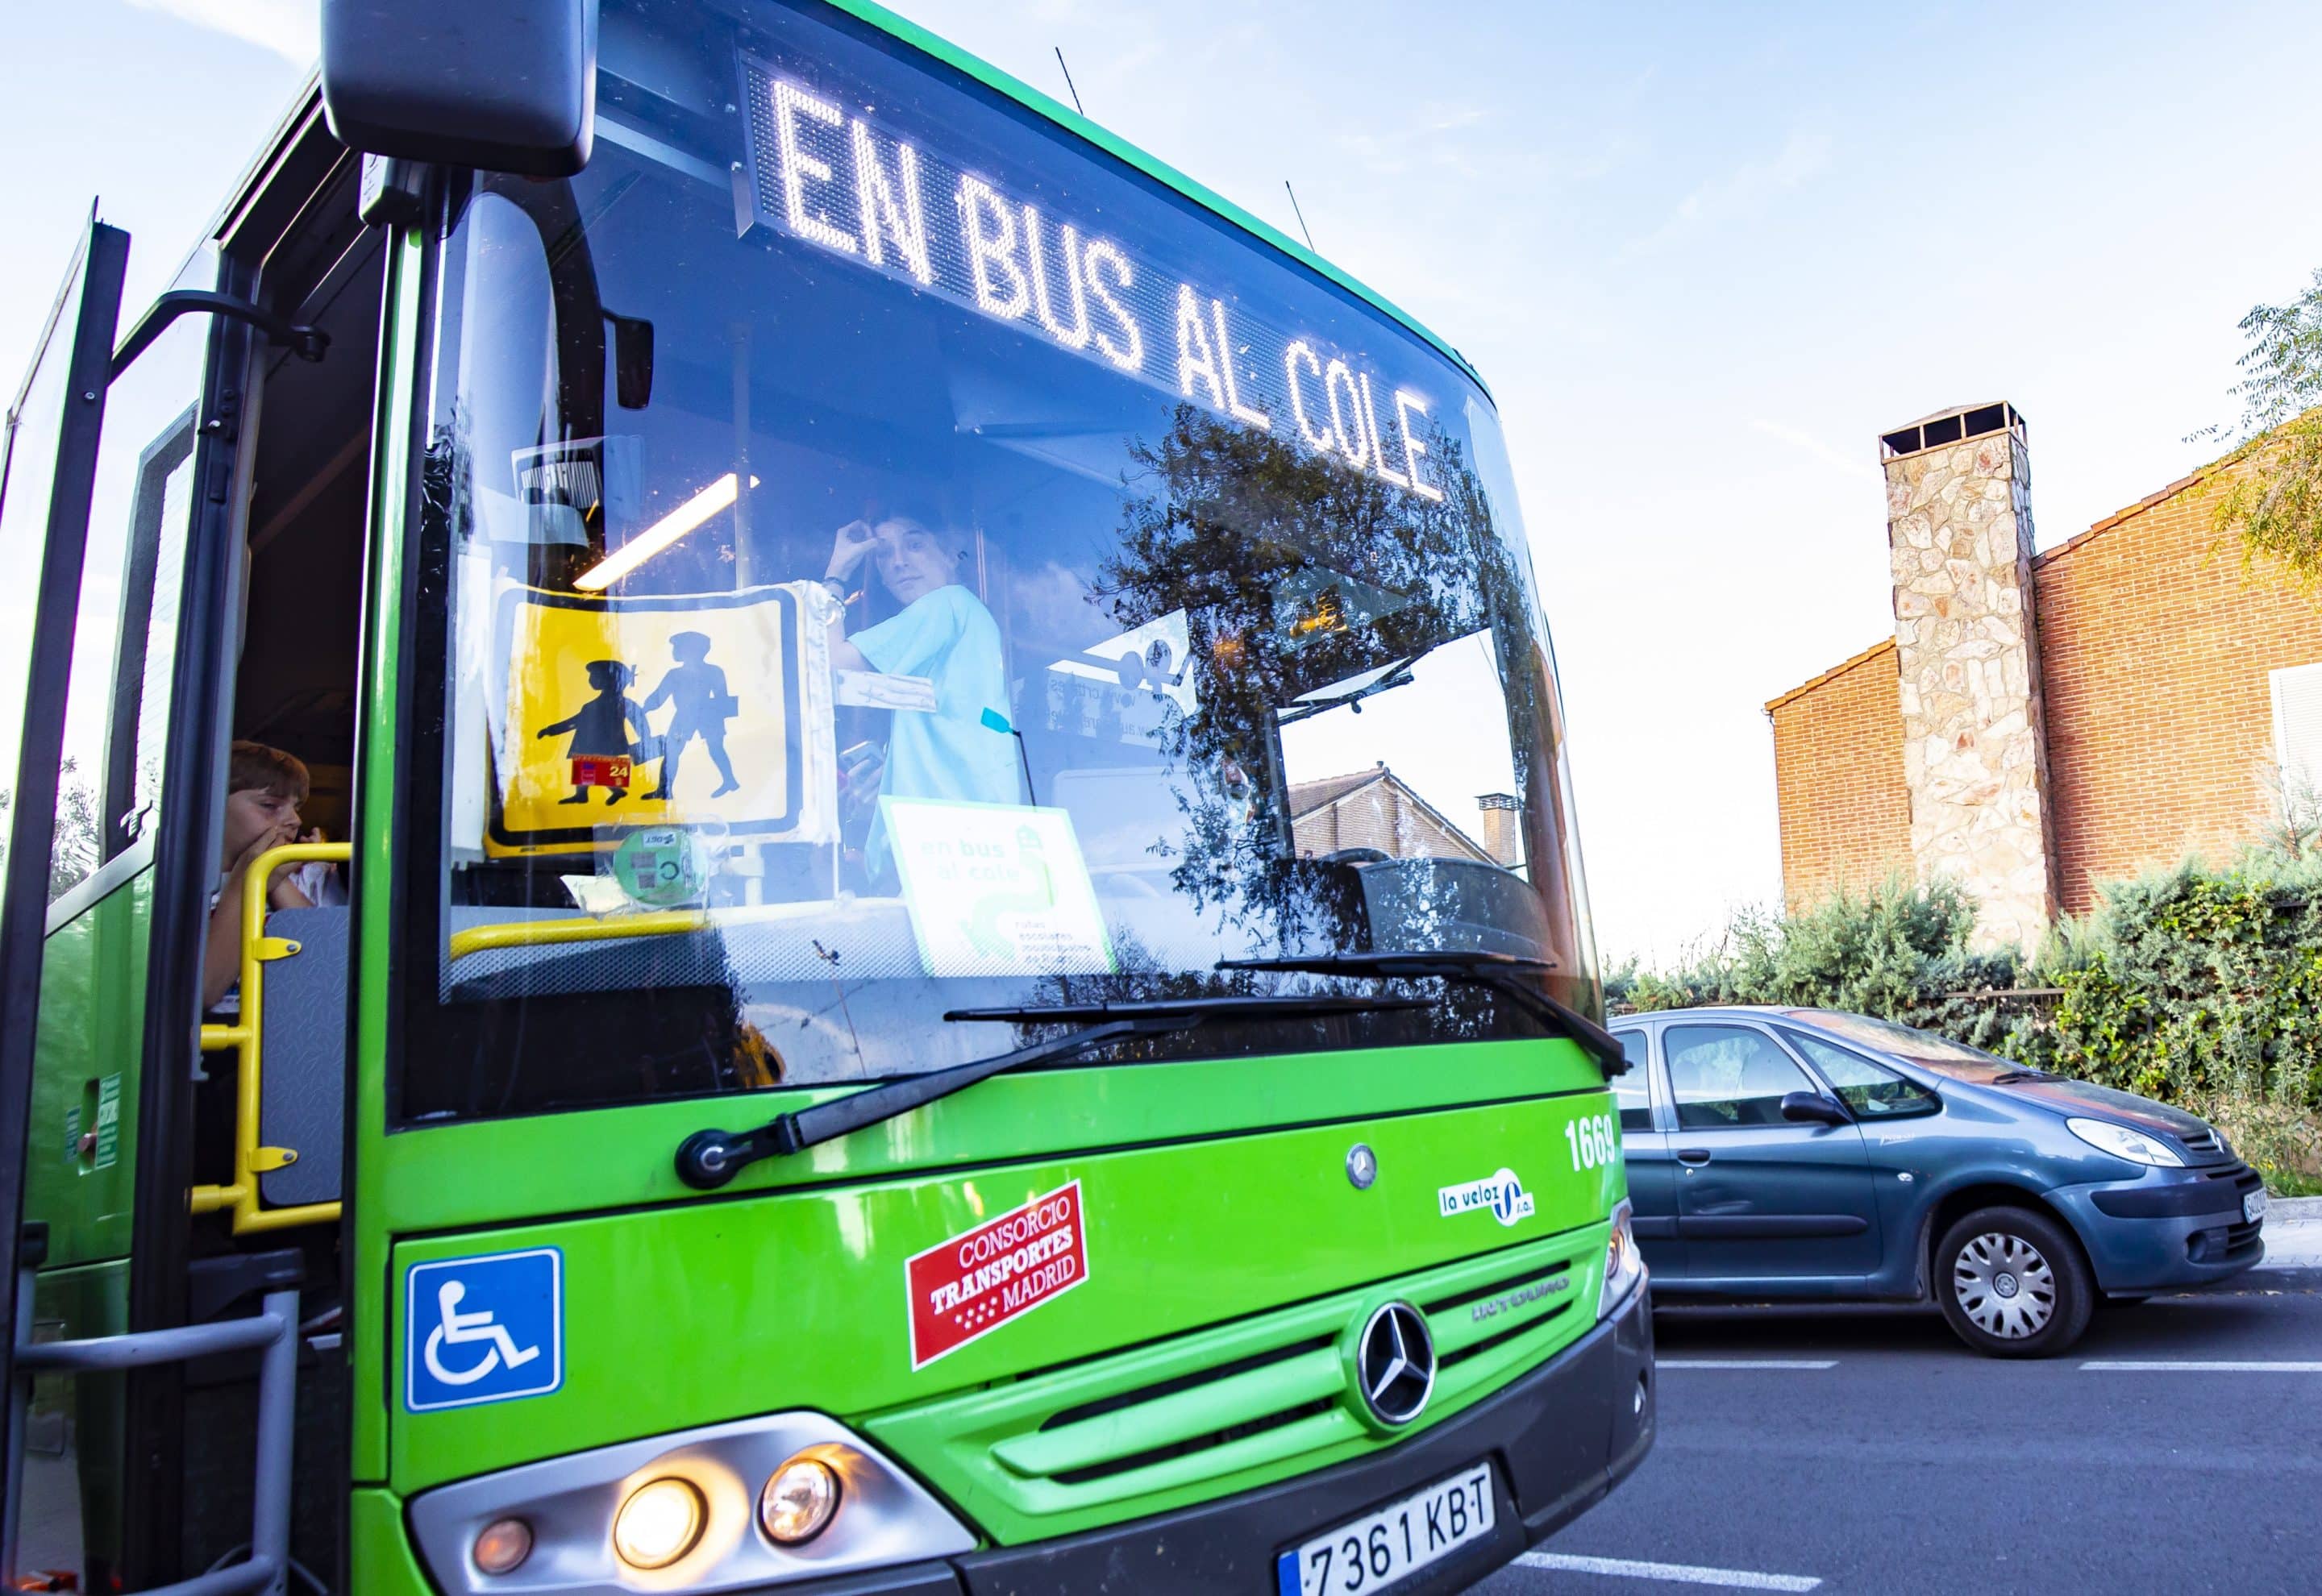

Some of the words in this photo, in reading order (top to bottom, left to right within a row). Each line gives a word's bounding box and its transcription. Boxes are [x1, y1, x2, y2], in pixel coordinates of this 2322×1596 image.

[772, 80, 932, 285] EN
[958, 174, 1143, 370] BUS
[1176, 283, 1271, 430] AL
[1285, 339, 1443, 502] COLE
[610, 766, 628, 778] 24
[920, 840, 953, 855] en
[959, 837, 1005, 858] bus
[937, 863, 957, 880] al
[968, 863, 1020, 881] cole
[1565, 1114, 1615, 1172] 1669
[1442, 1192, 1458, 1212] la
[1463, 1183, 1500, 1207] veloz
[959, 1196, 1072, 1269] CONSORCIO
[930, 1224, 1074, 1315] TRANSPORTES
[1002, 1254, 1076, 1313] MADRID
[1311, 1511, 1412, 1596] 7361
[1425, 1473, 1487, 1552] KBT
